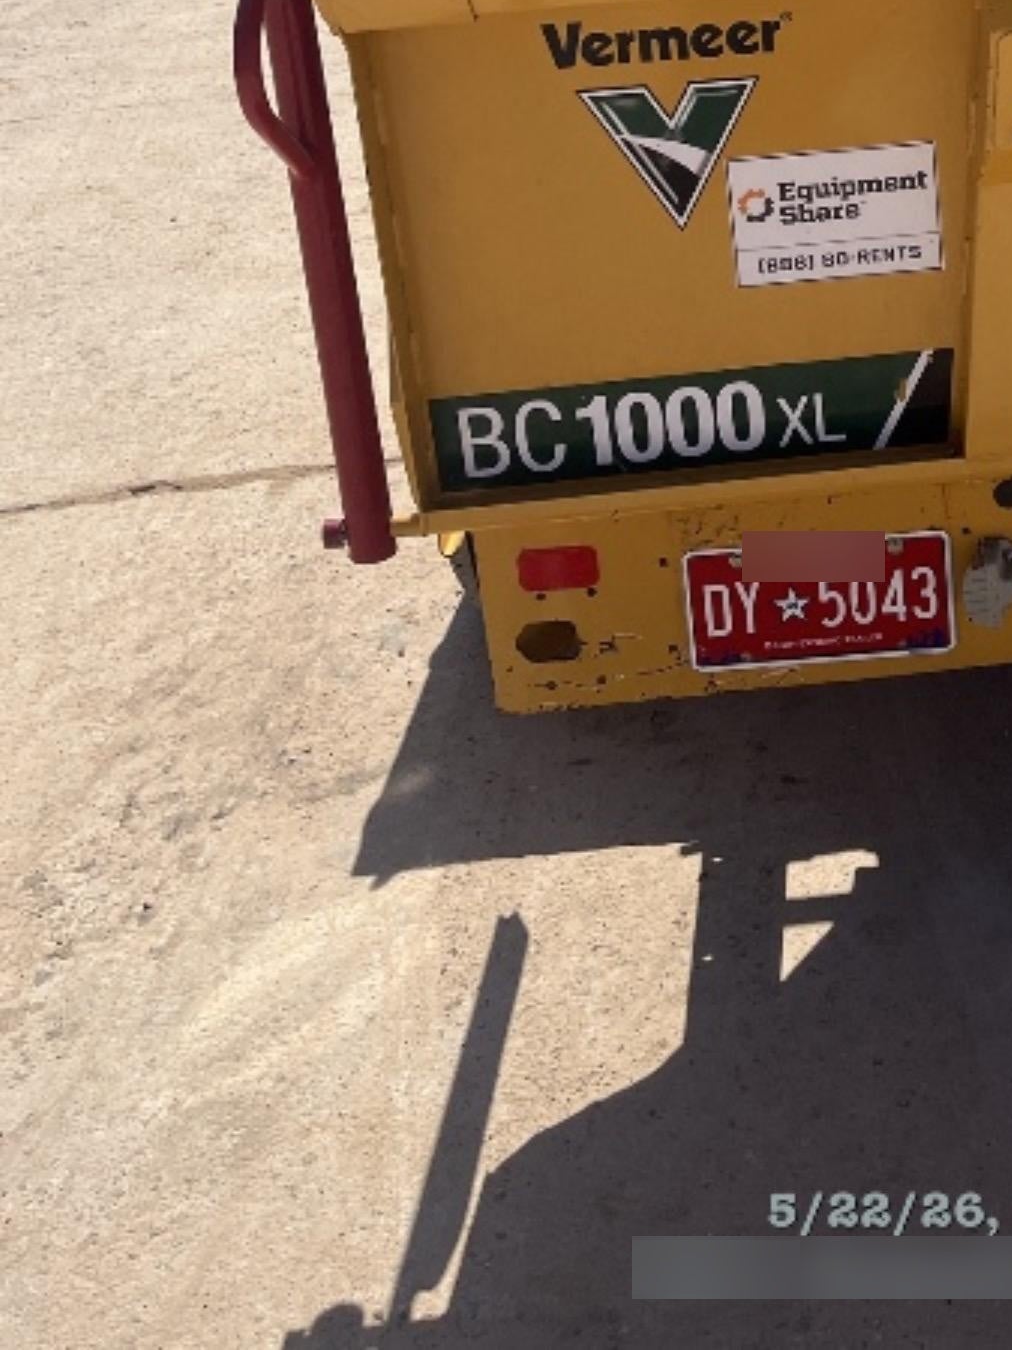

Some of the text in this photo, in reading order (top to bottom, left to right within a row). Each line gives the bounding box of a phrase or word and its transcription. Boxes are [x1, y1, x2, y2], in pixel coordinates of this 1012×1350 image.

[540, 18, 782, 70] Vermeer
[777, 170, 928, 204] Equipment
[779, 203, 861, 225] Share
[777, 393, 847, 448] XL
